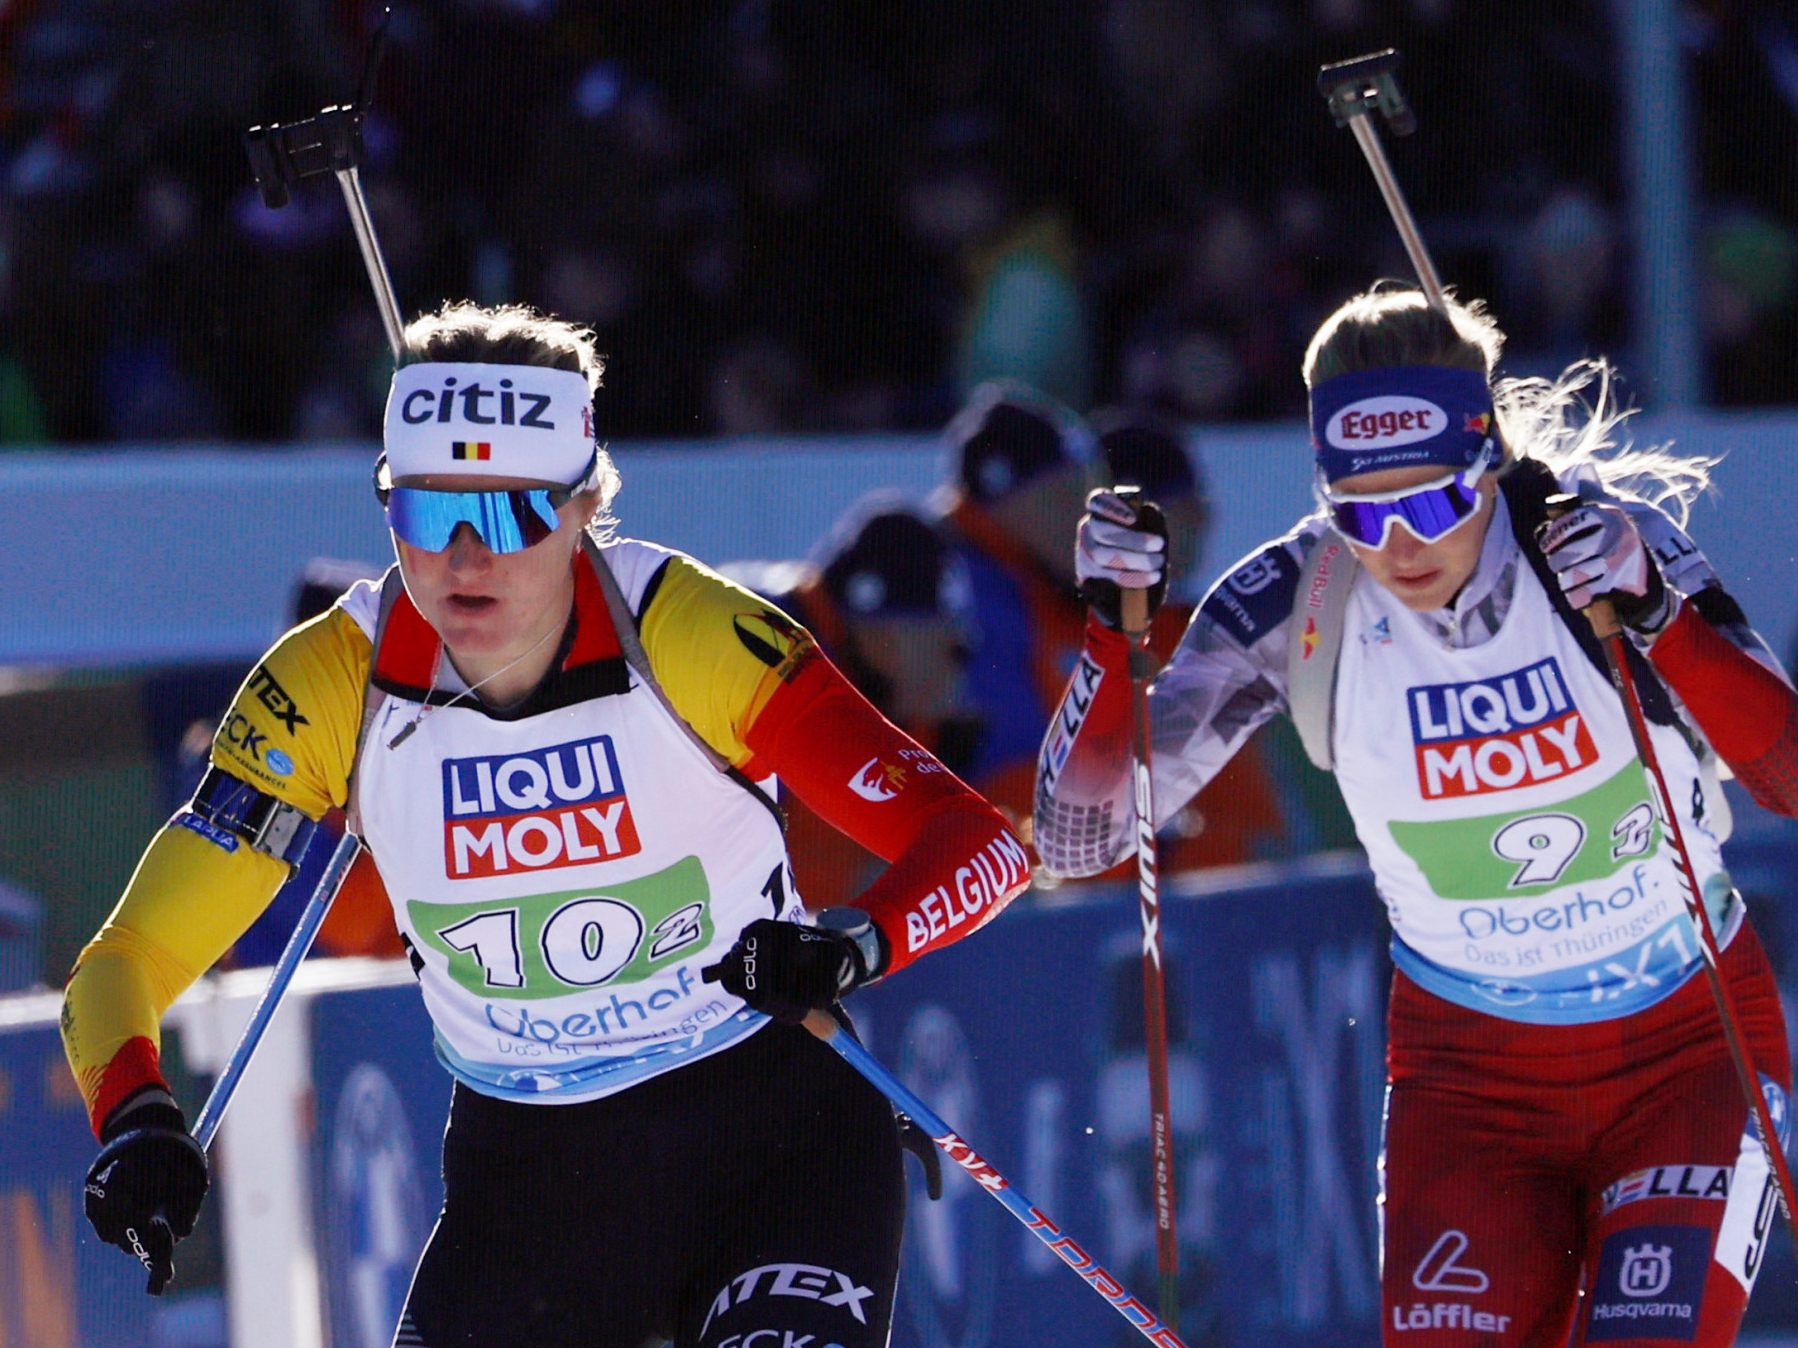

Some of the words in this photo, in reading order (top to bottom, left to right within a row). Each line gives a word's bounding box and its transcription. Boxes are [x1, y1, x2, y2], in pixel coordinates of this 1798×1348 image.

[402, 377, 555, 430] citiz
[1341, 409, 1431, 440] Egger
[1415, 664, 1567, 739] LIQUI
[451, 742, 616, 815] LIQUI
[1423, 715, 1583, 796] MOLY
[184, 816, 234, 848] LAPUA
[452, 802, 625, 874] MOLY
[1493, 813, 1584, 887] 9
[907, 831, 1029, 953] BELGIUM
[438, 898, 643, 988] 10
[650, 903, 703, 960] 2
[1465, 942, 1510, 966] Das
[1516, 943, 1543, 965] ist
[1553, 900, 1668, 957] Thüringen
[1394, 1303, 1511, 1333] Löffler
[1594, 1302, 1692, 1321] Husqvarna
